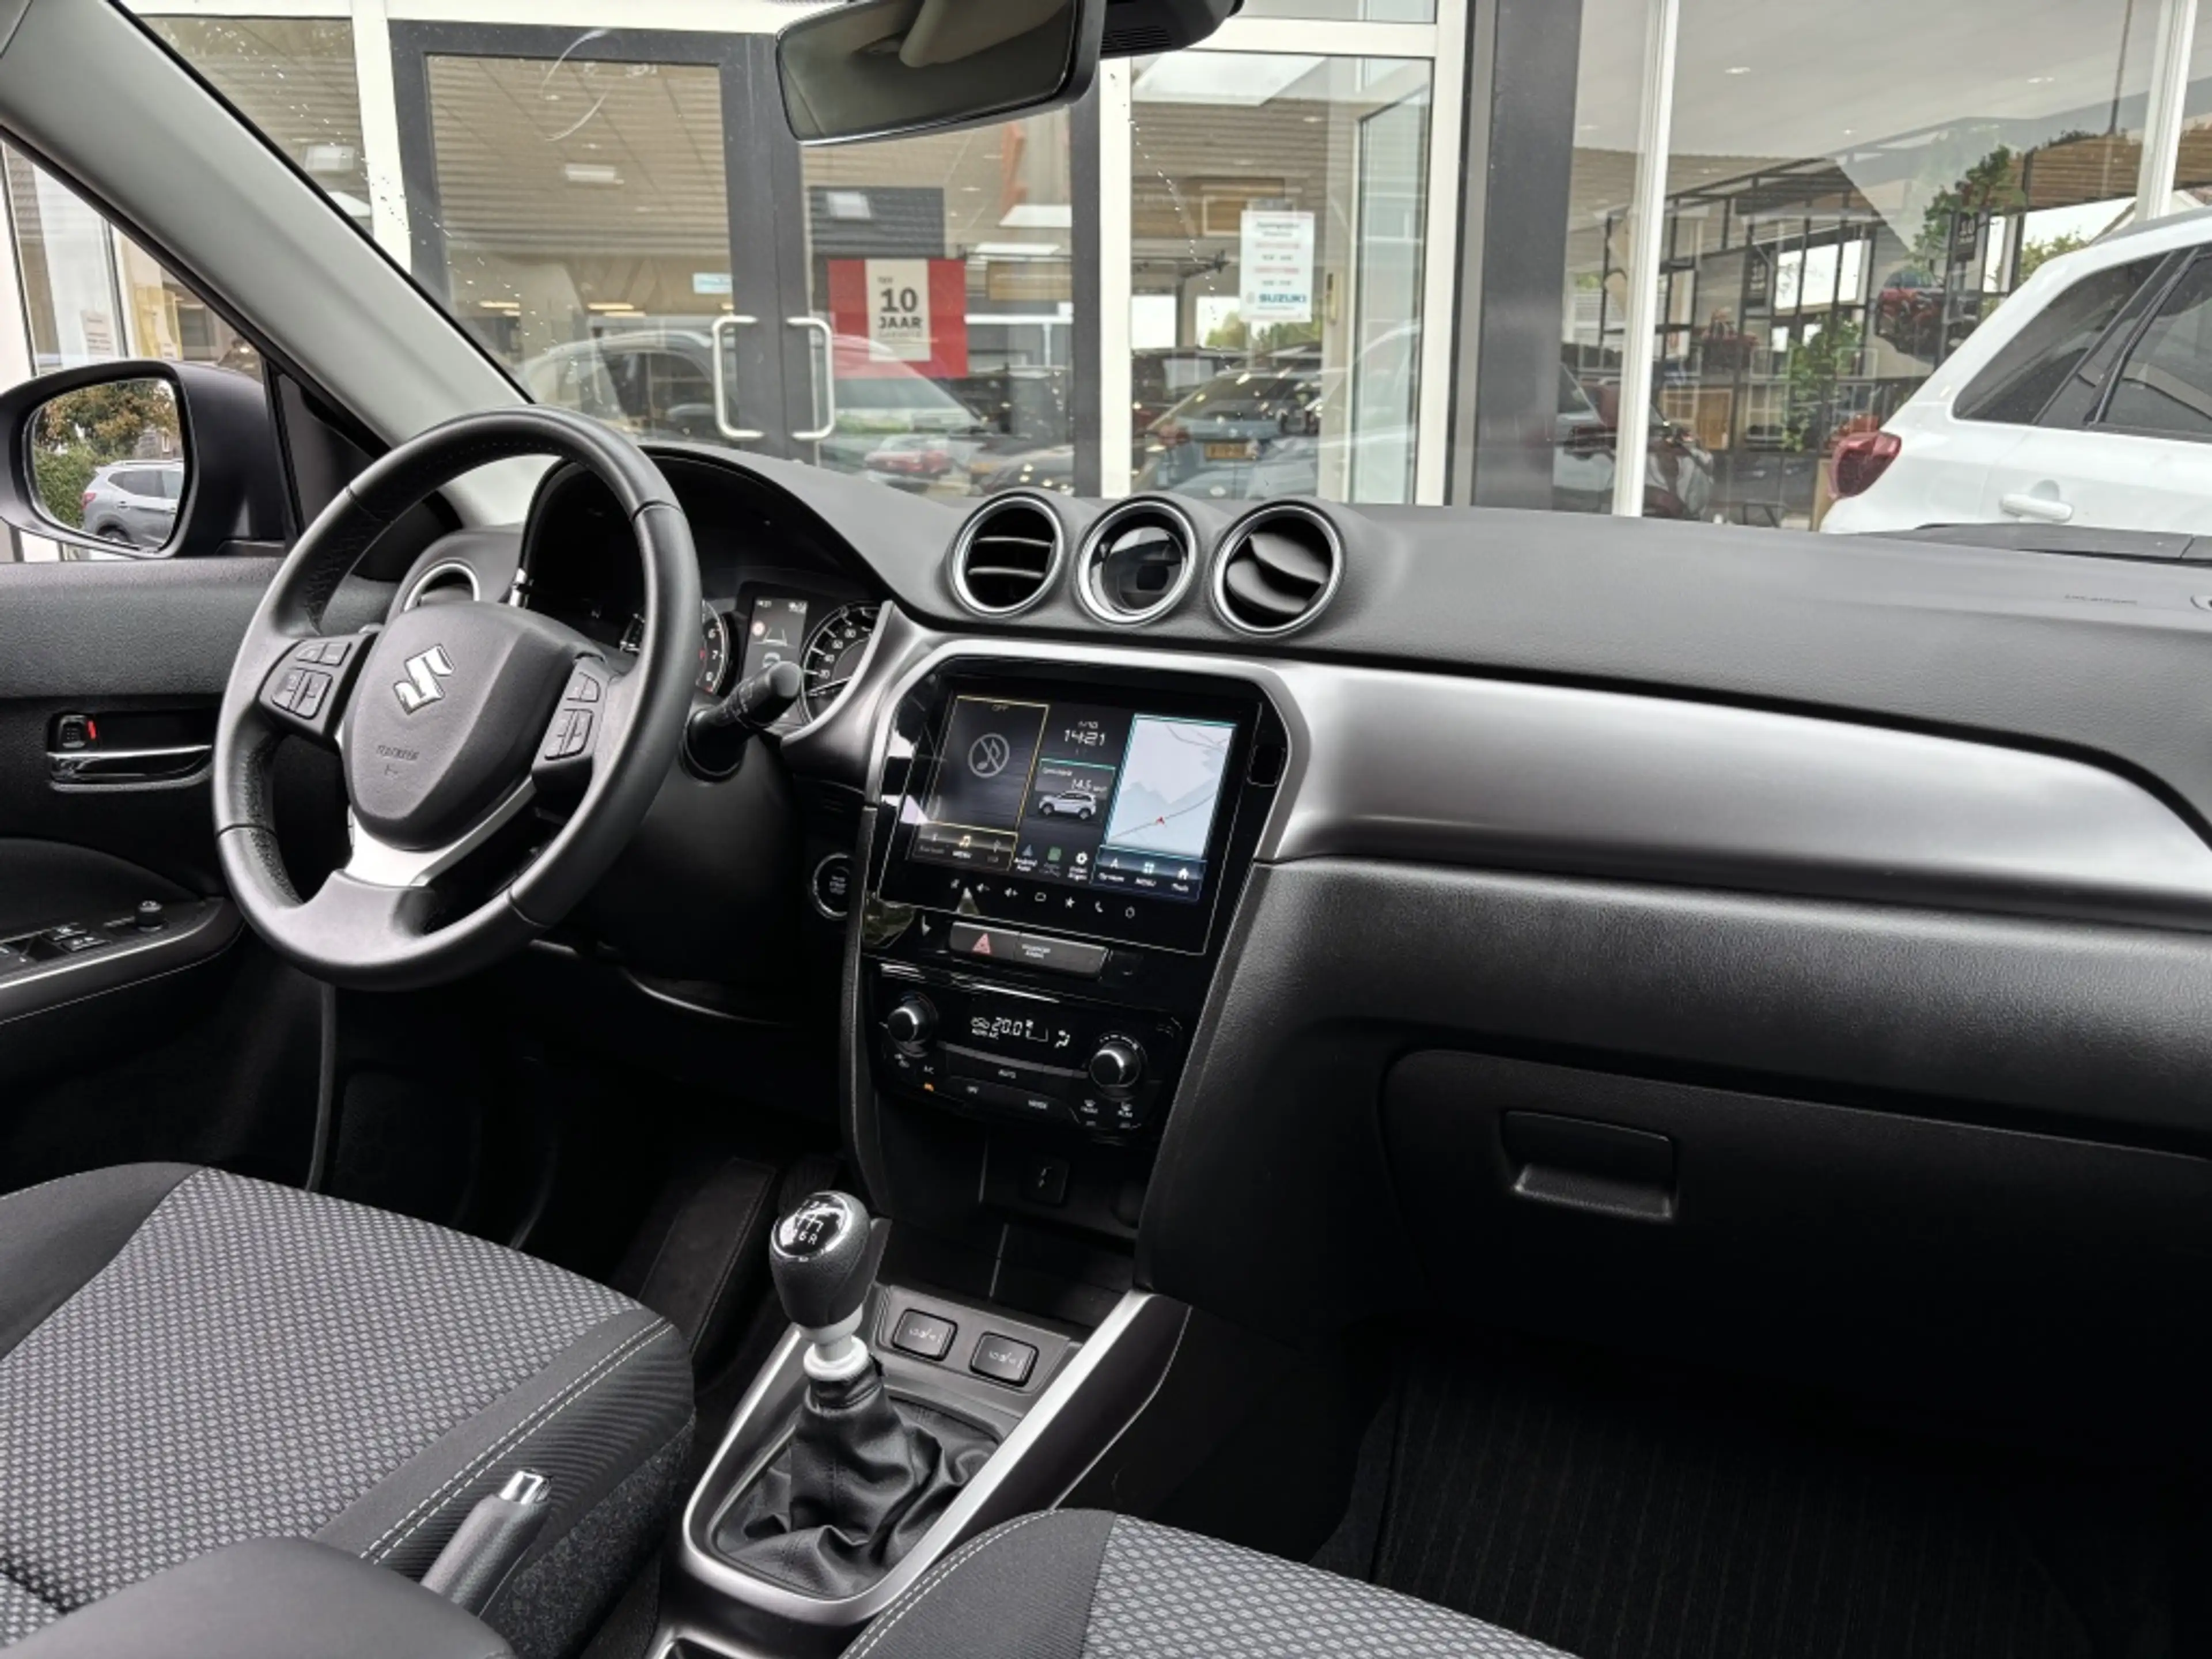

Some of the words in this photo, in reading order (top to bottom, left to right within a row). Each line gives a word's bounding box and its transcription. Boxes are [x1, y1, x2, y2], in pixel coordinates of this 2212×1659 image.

[881, 287, 919, 313] 10
[1259, 294, 1306, 303] SUZUKI
[879, 316, 922, 329] JAAR
[712, 650, 718, 660] 7
[799, 1230, 808, 1241] 6
[808, 1233, 817, 1245] R
